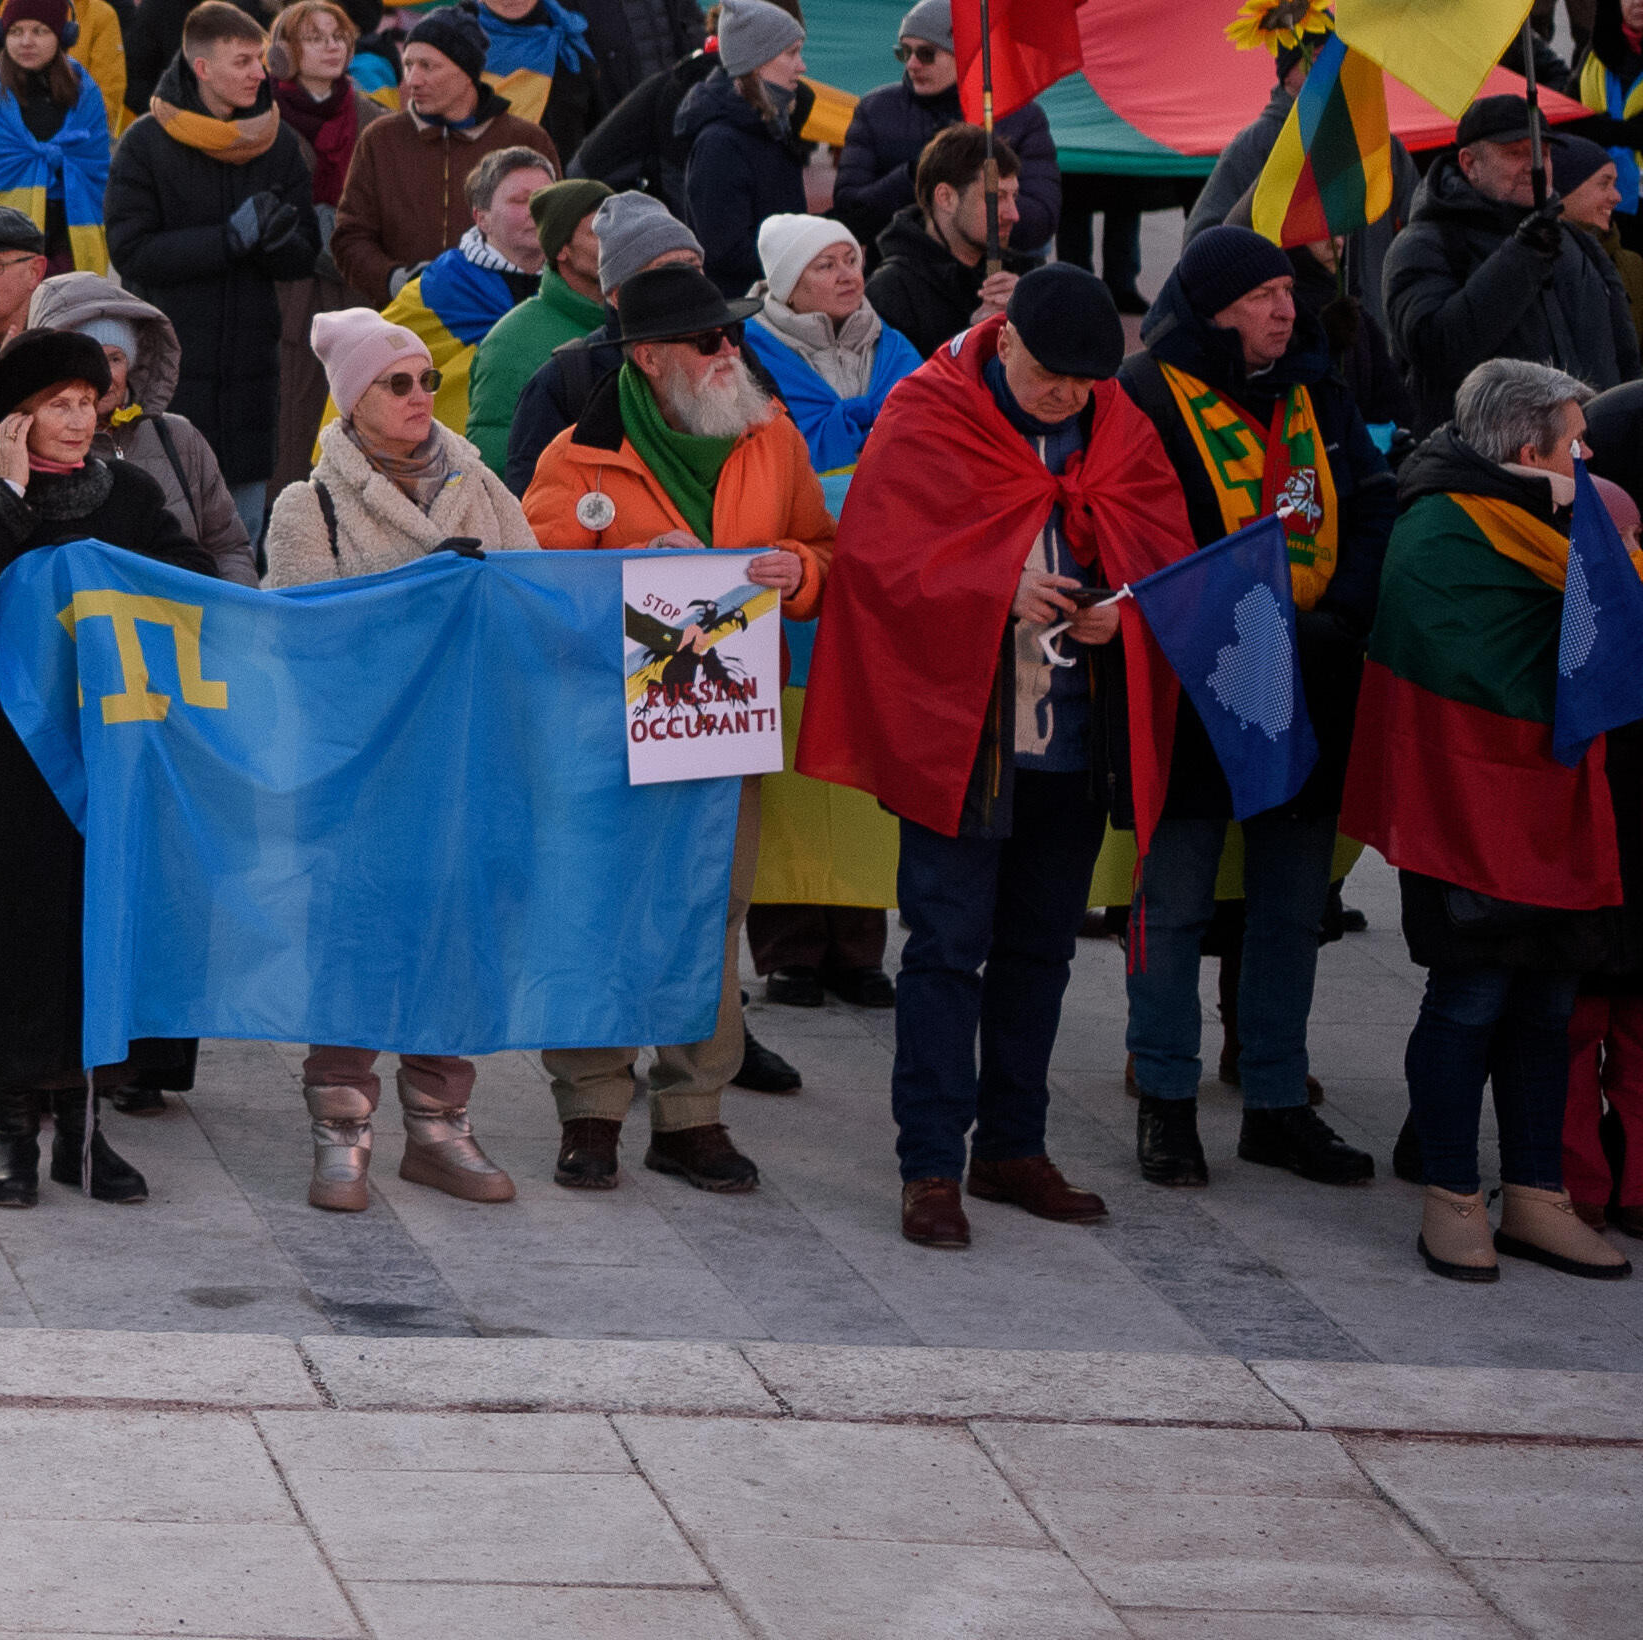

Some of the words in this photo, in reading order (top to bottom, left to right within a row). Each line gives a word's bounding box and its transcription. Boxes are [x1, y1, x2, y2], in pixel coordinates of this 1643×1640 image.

[642, 593, 681, 620] STOP
[646, 676, 757, 708] RUSSIAN
[631, 707, 776, 743] OCCUPANT!
